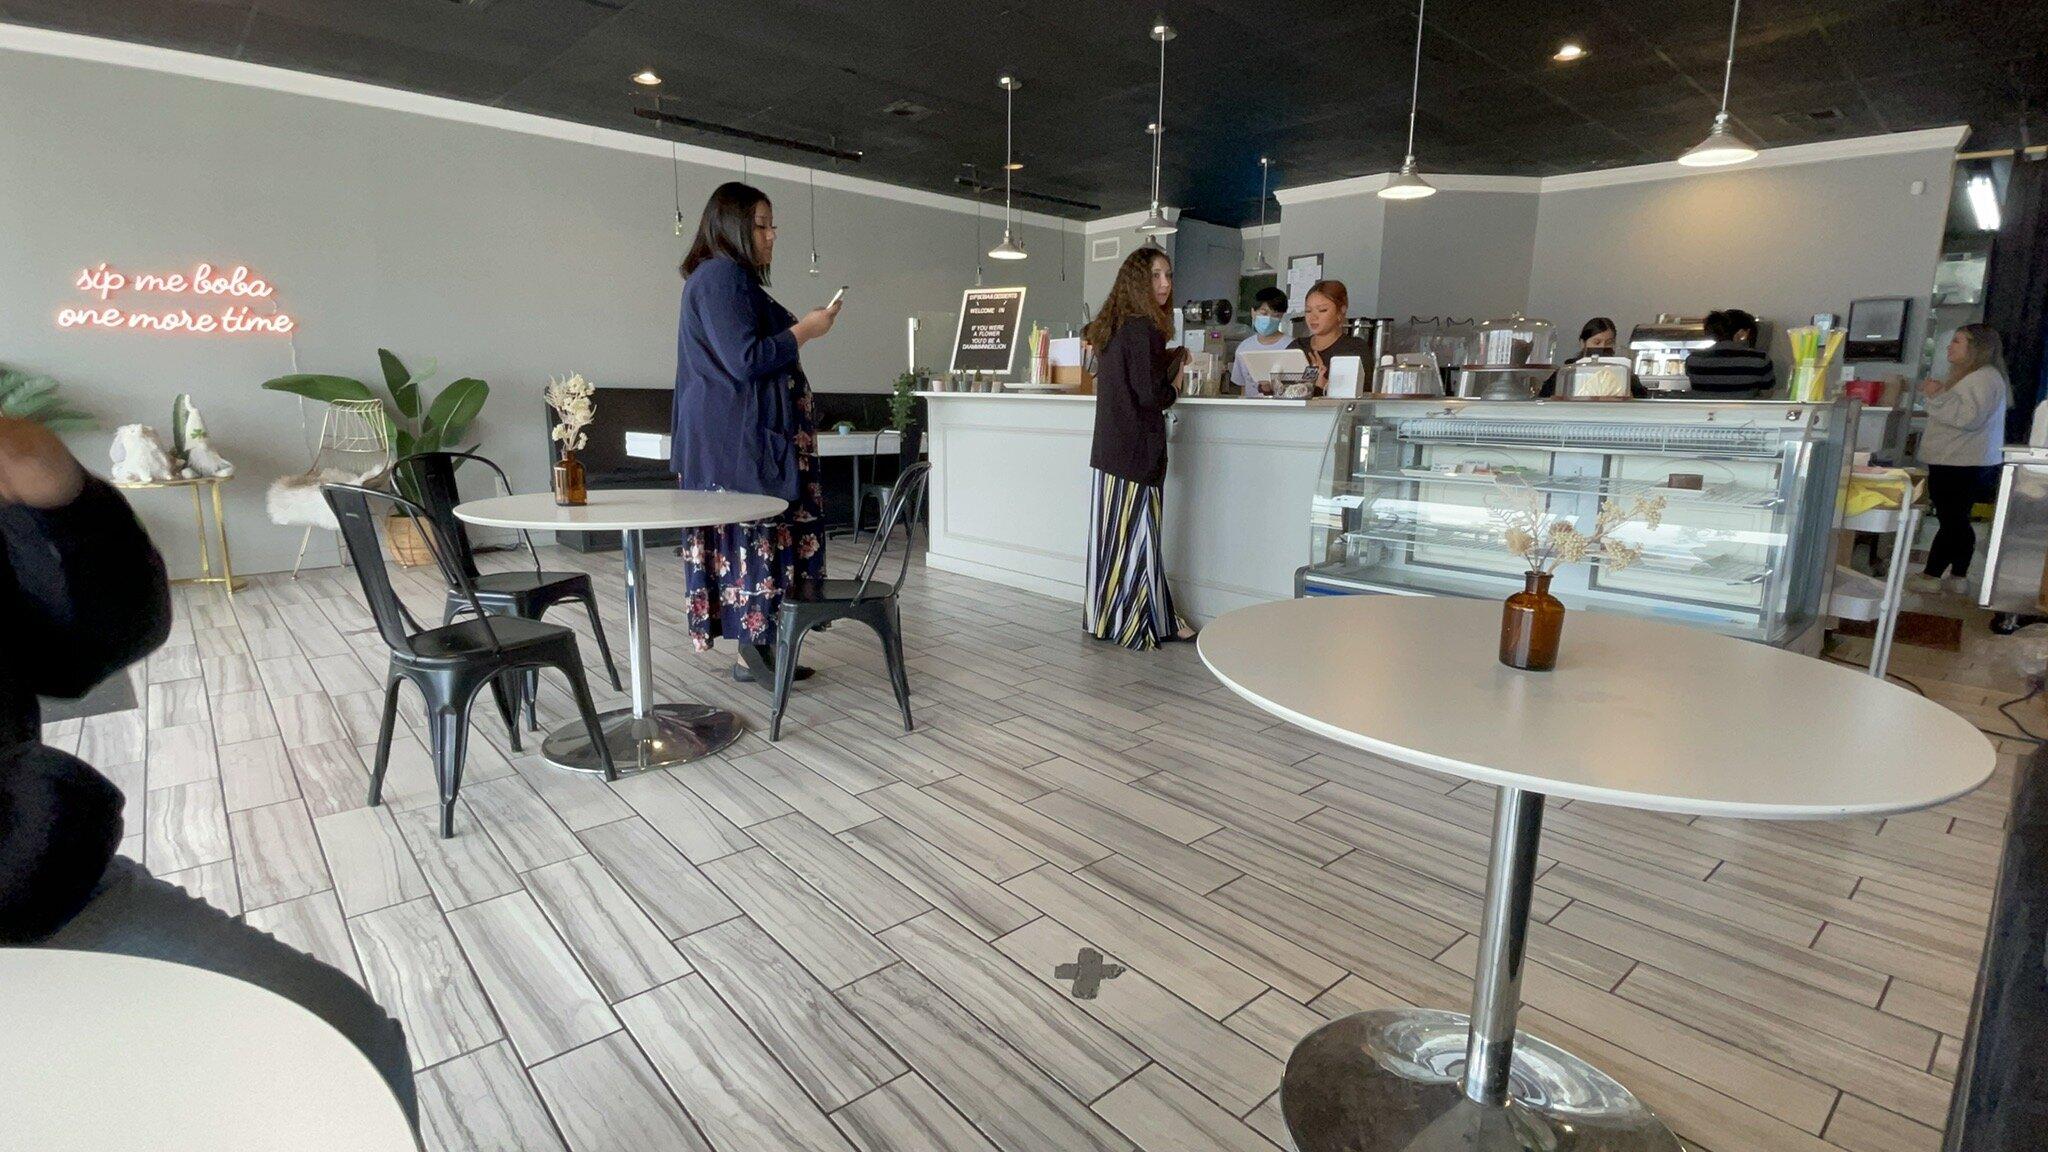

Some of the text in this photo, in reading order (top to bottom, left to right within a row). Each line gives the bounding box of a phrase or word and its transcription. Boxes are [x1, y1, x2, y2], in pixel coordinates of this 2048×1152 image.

[76, 263, 273, 300] sip me boba
[57, 306, 294, 333] one more time
